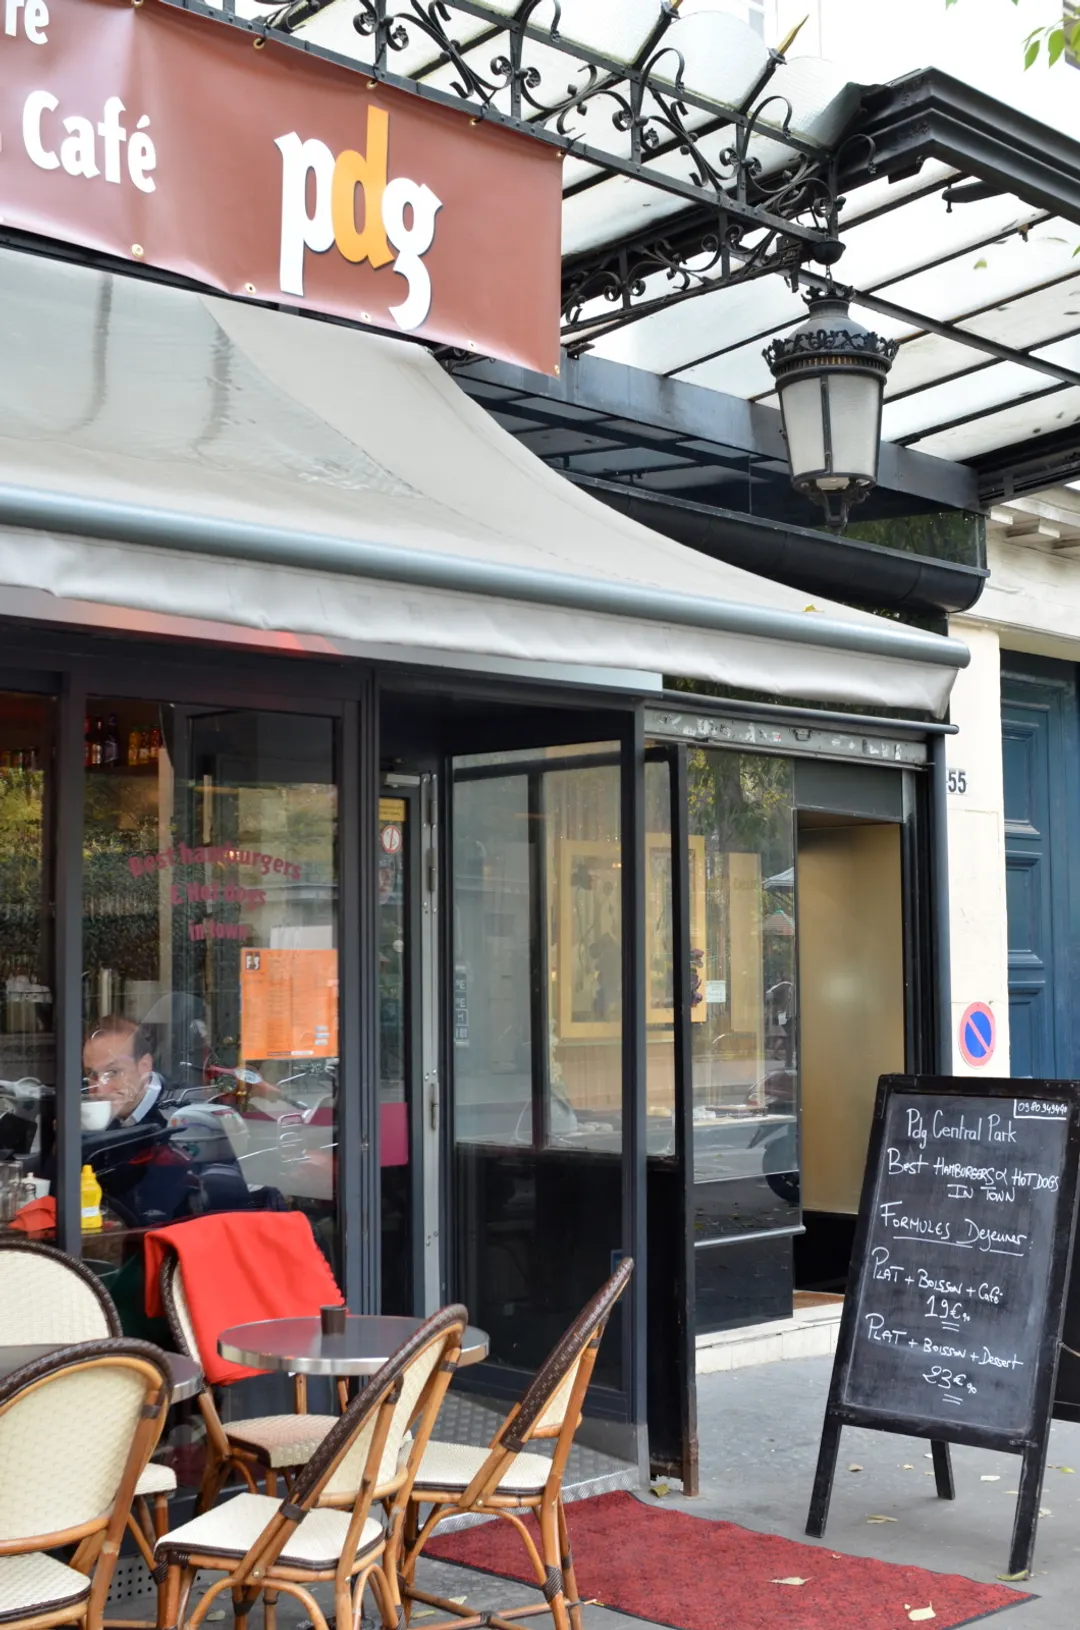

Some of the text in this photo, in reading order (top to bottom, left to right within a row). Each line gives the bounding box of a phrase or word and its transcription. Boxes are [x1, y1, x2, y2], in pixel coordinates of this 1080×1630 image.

[22, 90, 157, 193] Café
[273, 105, 443, 331] pdg
[948, 771, 967, 794] 55
[128, 840, 302, 880] Best hamburgers
[186, 881, 219, 902] Hot
[224, 879, 266, 911] dogs
[188, 918, 249, 941] in town
[906, 1108, 1017, 1149] Pdg Central Park
[887, 1147, 929, 1175] Best
[947, 1184, 1016, 1202] IN TOWN
